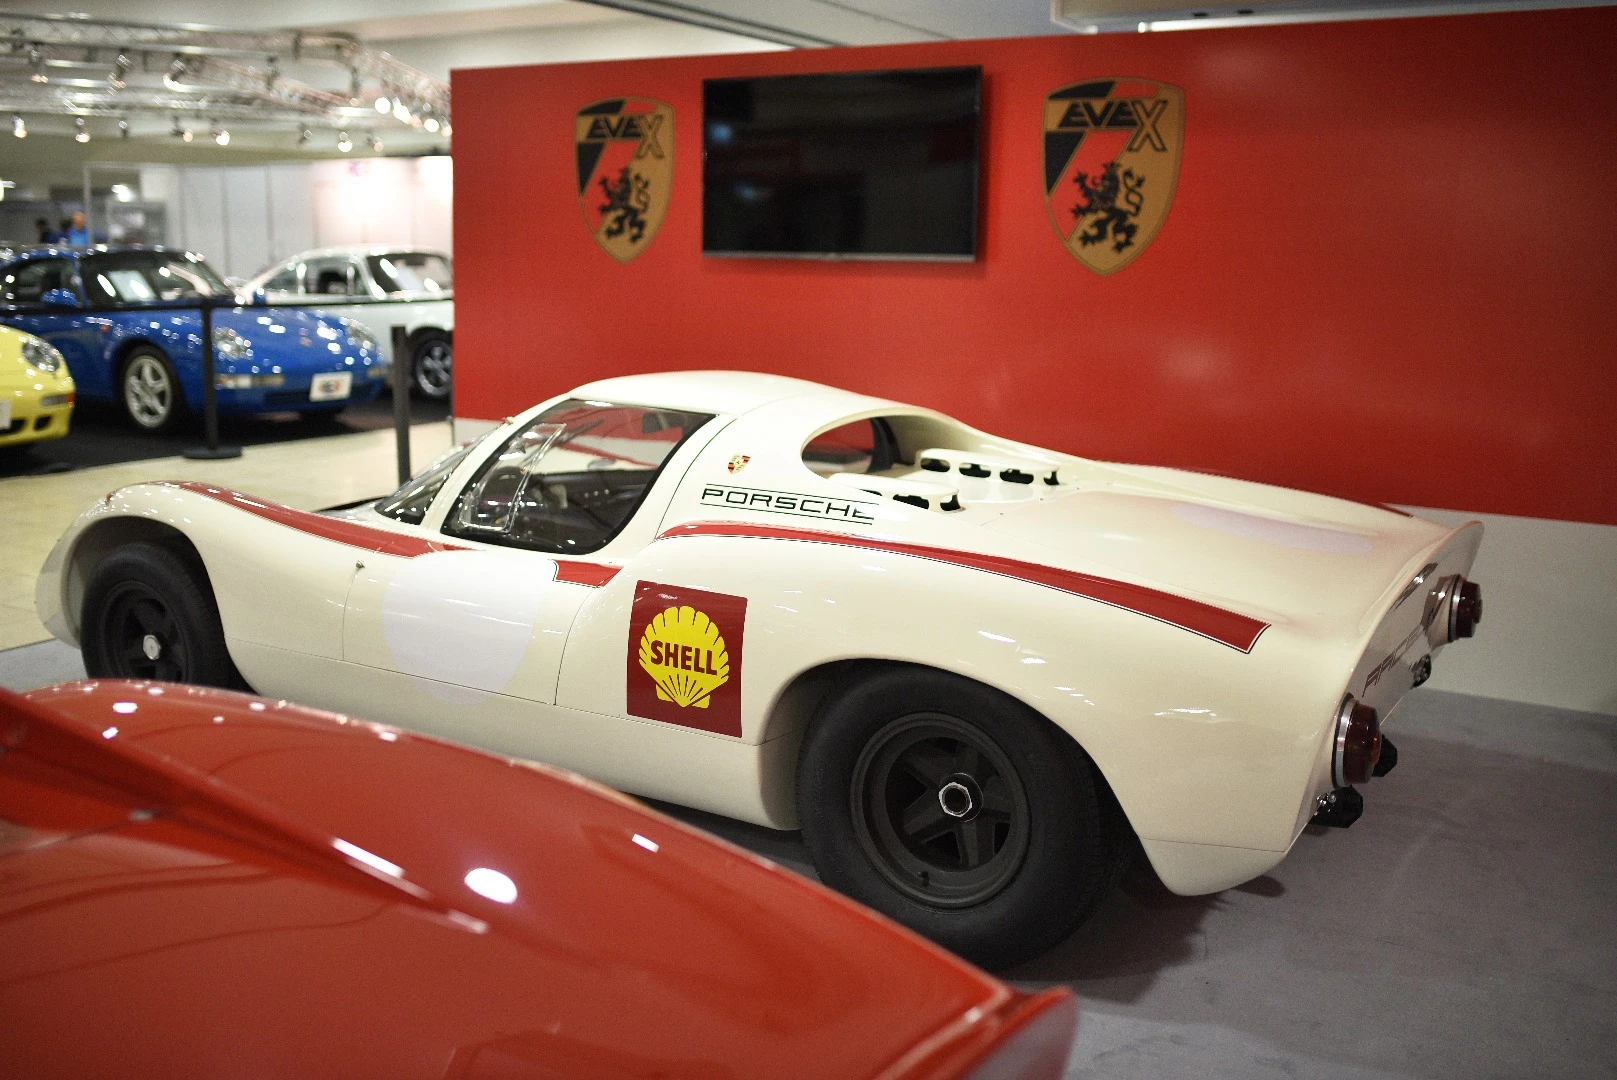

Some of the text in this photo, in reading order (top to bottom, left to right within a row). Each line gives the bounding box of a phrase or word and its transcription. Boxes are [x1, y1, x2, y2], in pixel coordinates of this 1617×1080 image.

[586, 114, 664, 159] EVEX
[1058, 99, 1168, 152] EVEX
[701, 487, 875, 520] PORSCHE
[650, 639, 718, 676] SHELL
